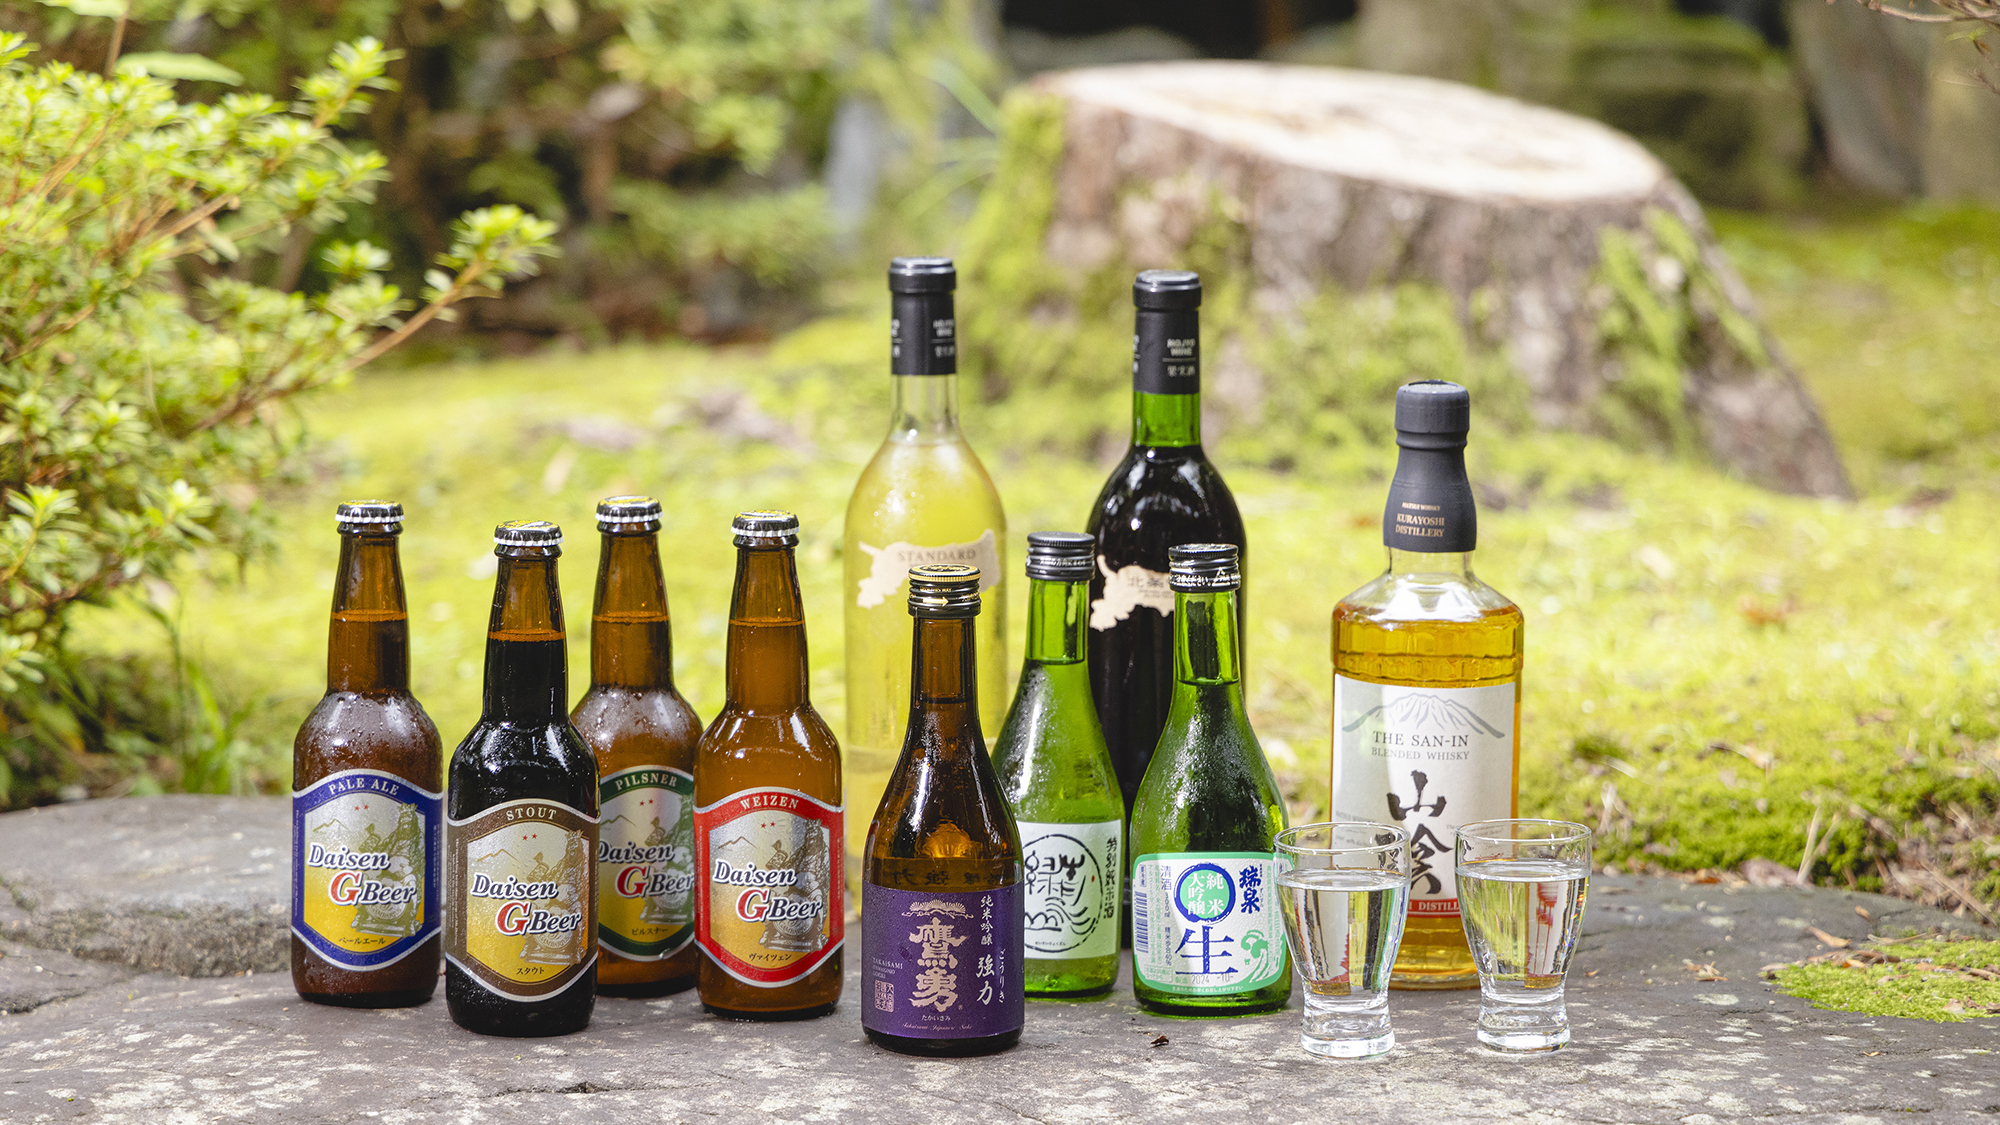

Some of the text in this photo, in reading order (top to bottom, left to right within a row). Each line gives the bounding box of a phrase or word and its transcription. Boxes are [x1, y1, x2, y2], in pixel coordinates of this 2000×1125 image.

[1397, 513, 1445, 526] KURAYOSHI
[1395, 524, 1445, 537] DISTILLERY
[898, 549, 977, 561] STANDARD
[1373, 731, 1469, 748] THE SAN-IN
[1371, 747, 1470, 760] BLENDED WHISKY
[329, 777, 400, 795] PALE ALE
[615, 773, 678, 791] PILSNER
[740, 795, 799, 810] WEIZEN
[506, 807, 557, 821] STOUT
[309, 844, 389, 869] Daisen
[714, 860, 796, 885] Daisen
[1161, 865, 1172, 890] 清酒
[472, 873, 557, 899] Daisen
[1188, 873, 1205, 915] 大吟醸
[1206, 873, 1224, 915] 純米
[1239, 865, 1261, 914] 瑞泉
[1418, 902, 1460, 911] DISTILL
[980, 894, 994, 946] 純米吟醸
[748, 952, 792, 963] ヴァイツェン
[1175, 925, 1238, 974] 生
[516, 966, 545, 975] スタウト
[976, 953, 995, 1006] 強力
[1191, 975, 1210, 985] 2024
